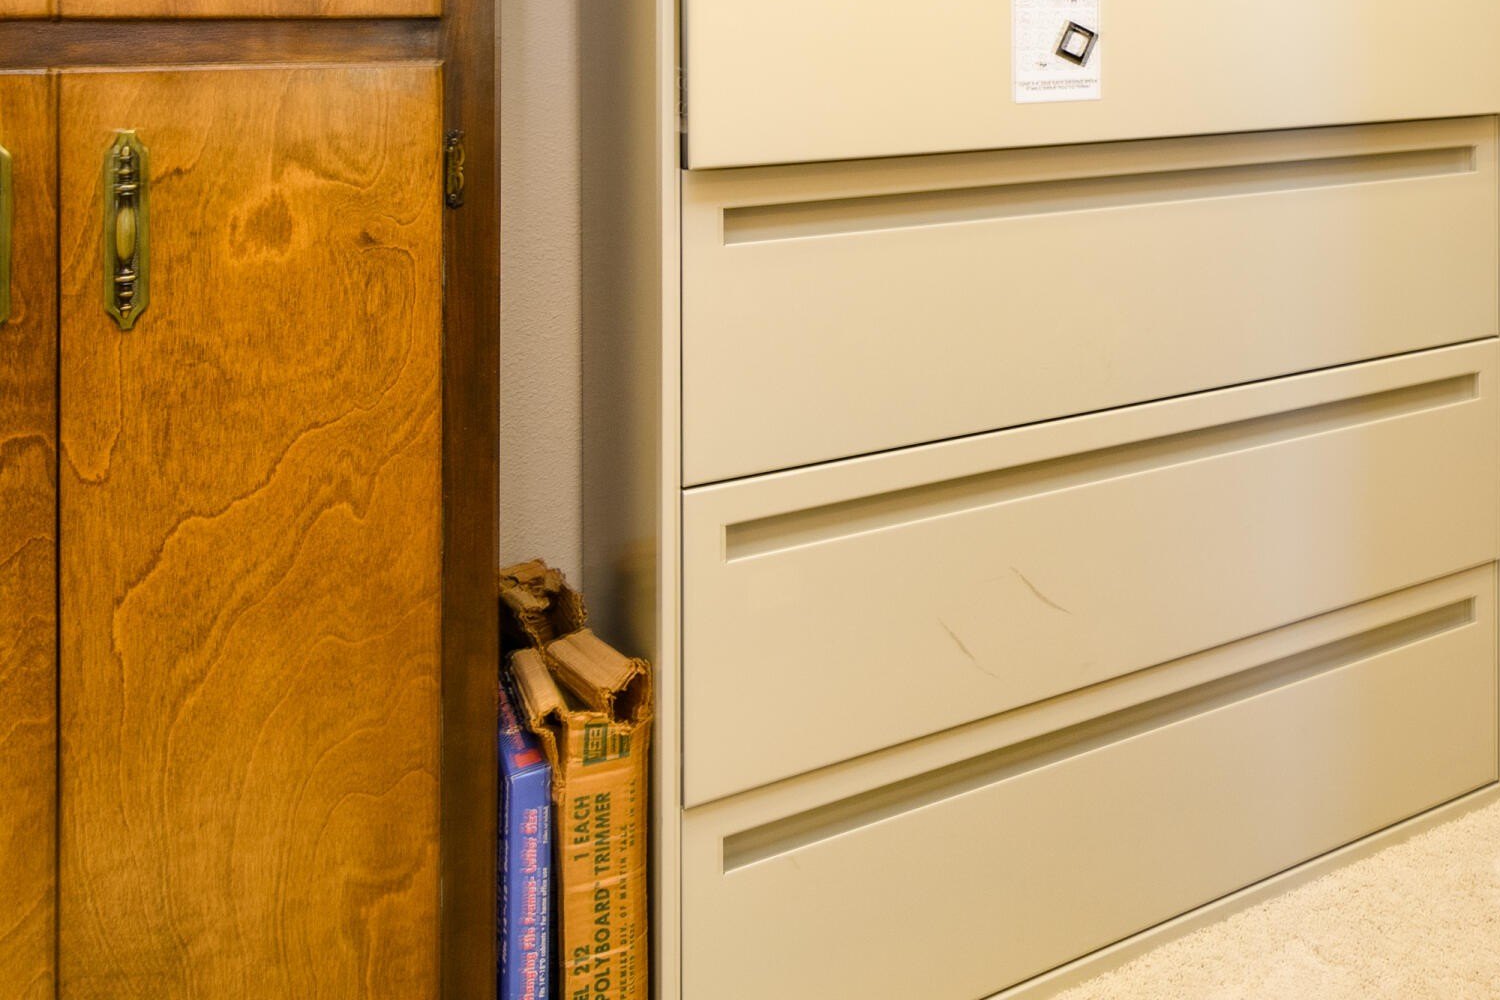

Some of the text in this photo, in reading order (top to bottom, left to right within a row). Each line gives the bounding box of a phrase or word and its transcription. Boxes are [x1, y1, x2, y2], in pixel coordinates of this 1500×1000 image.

[574, 796, 590, 843] EACH
[595, 792, 610, 874] TRIMMER
[574, 853, 589, 861] 1
[574, 945, 589, 975] 212
